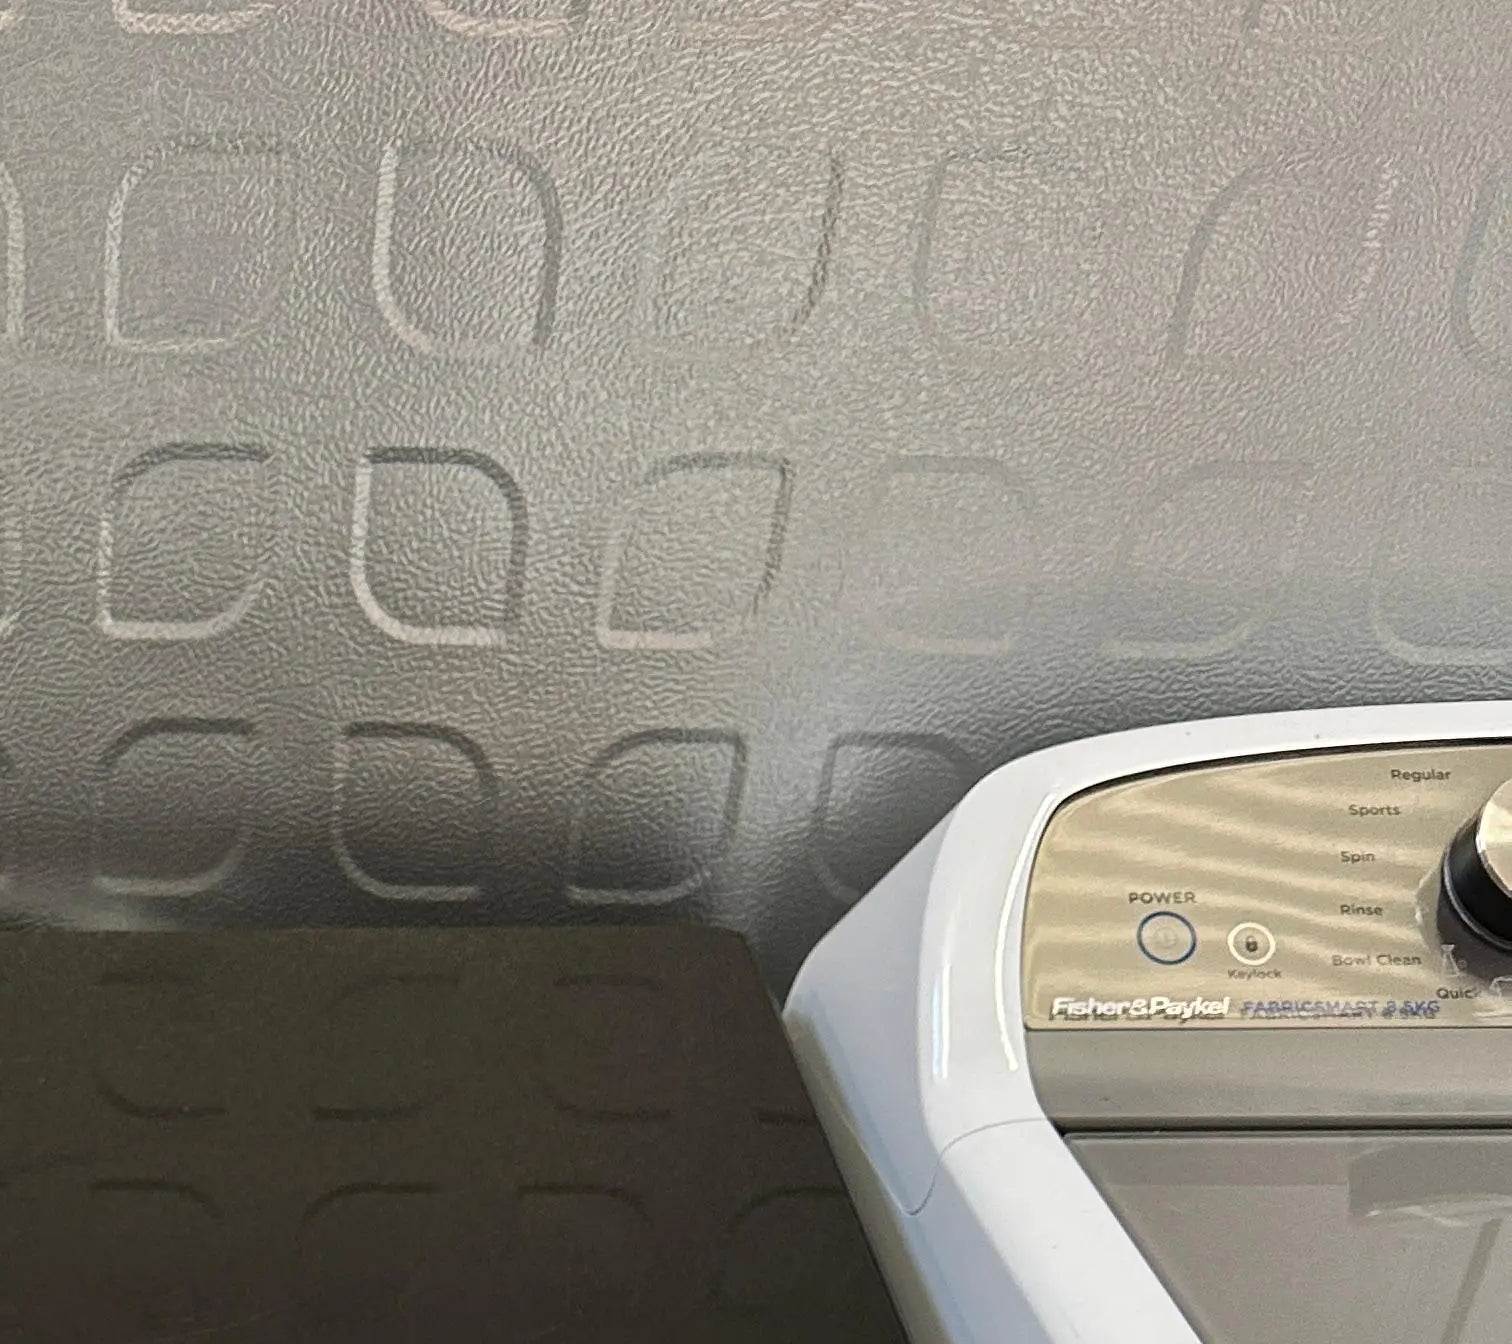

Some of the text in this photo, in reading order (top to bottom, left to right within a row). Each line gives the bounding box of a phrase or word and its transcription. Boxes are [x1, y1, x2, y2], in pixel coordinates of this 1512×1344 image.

[1390, 768, 1451, 784] Regular
[1348, 804, 1401, 818] Sports
[1340, 850, 1376, 865] Spin
[1128, 891, 1197, 905] POWER
[1340, 903, 1384, 917] Rinse
[1332, 953, 1423, 966] Bowl Clean
[1226, 967, 1283, 981] Keylock
